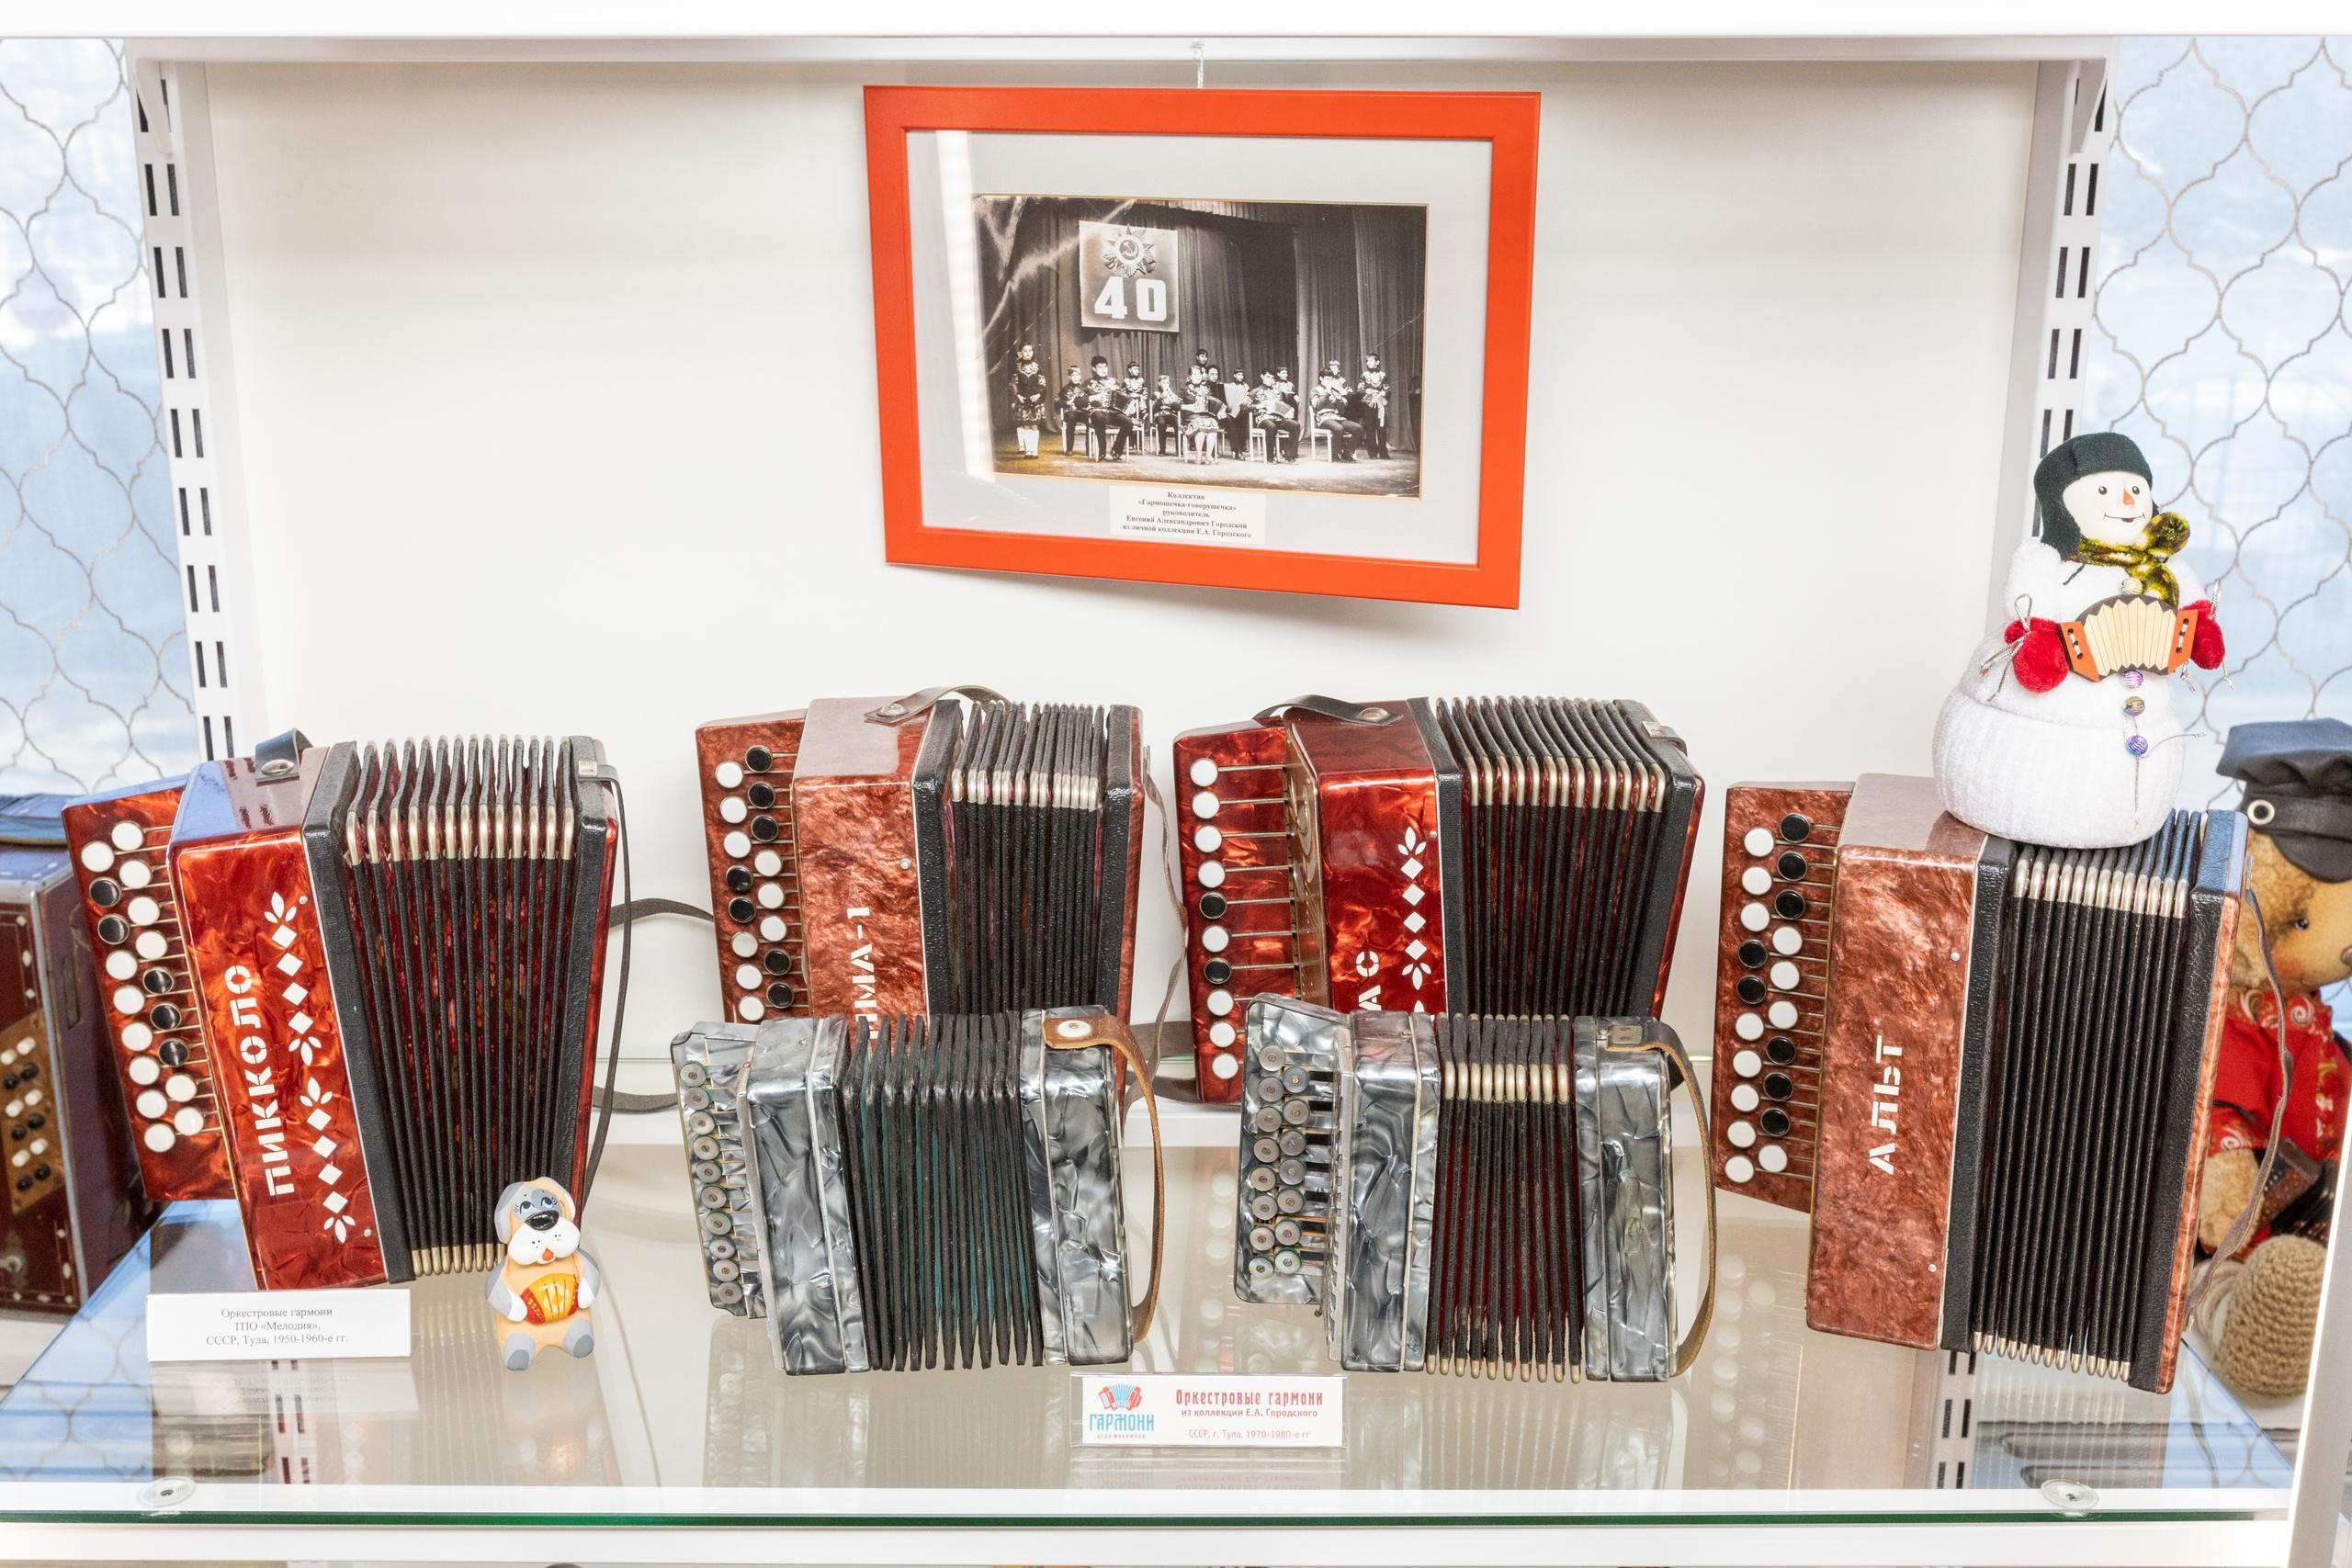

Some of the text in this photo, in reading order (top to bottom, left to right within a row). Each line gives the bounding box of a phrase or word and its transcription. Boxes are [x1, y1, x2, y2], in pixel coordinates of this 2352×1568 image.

[1094, 276, 1168, 321] 40
[1167, 491, 1205, 501] Коллектив
[1138, 499, 1237, 511] «Гармошечка-говорушечка»
[1162, 510, 1211, 518] руководитель
[1126, 514, 1248, 530] Евгений Александрович Городской
[1213, 529, 1252, 538] Городского
[224, 965, 295, 1196] ПИККОЛО
[1869, 1034, 1903, 1176] АЛЬТ
[221, 1308, 333, 1320] Оркестровые гармони
[233, 1321, 258, 1331] ТПО
[206, 1335, 240, 1346] СССР,
[243, 1334, 270, 1347] Тула,
[273, 1333, 334, 1344] 1950-1960-е
[1176, 1389, 1323, 1406] Оркестровые гармони
[1193, 1409, 1243, 1417] коллекции
[1246, 1408, 1263, 1416] Е.А.
[1266, 1408, 1318, 1418] Городского
[1246, 1429, 1299, 1438] 1970-1980-е
